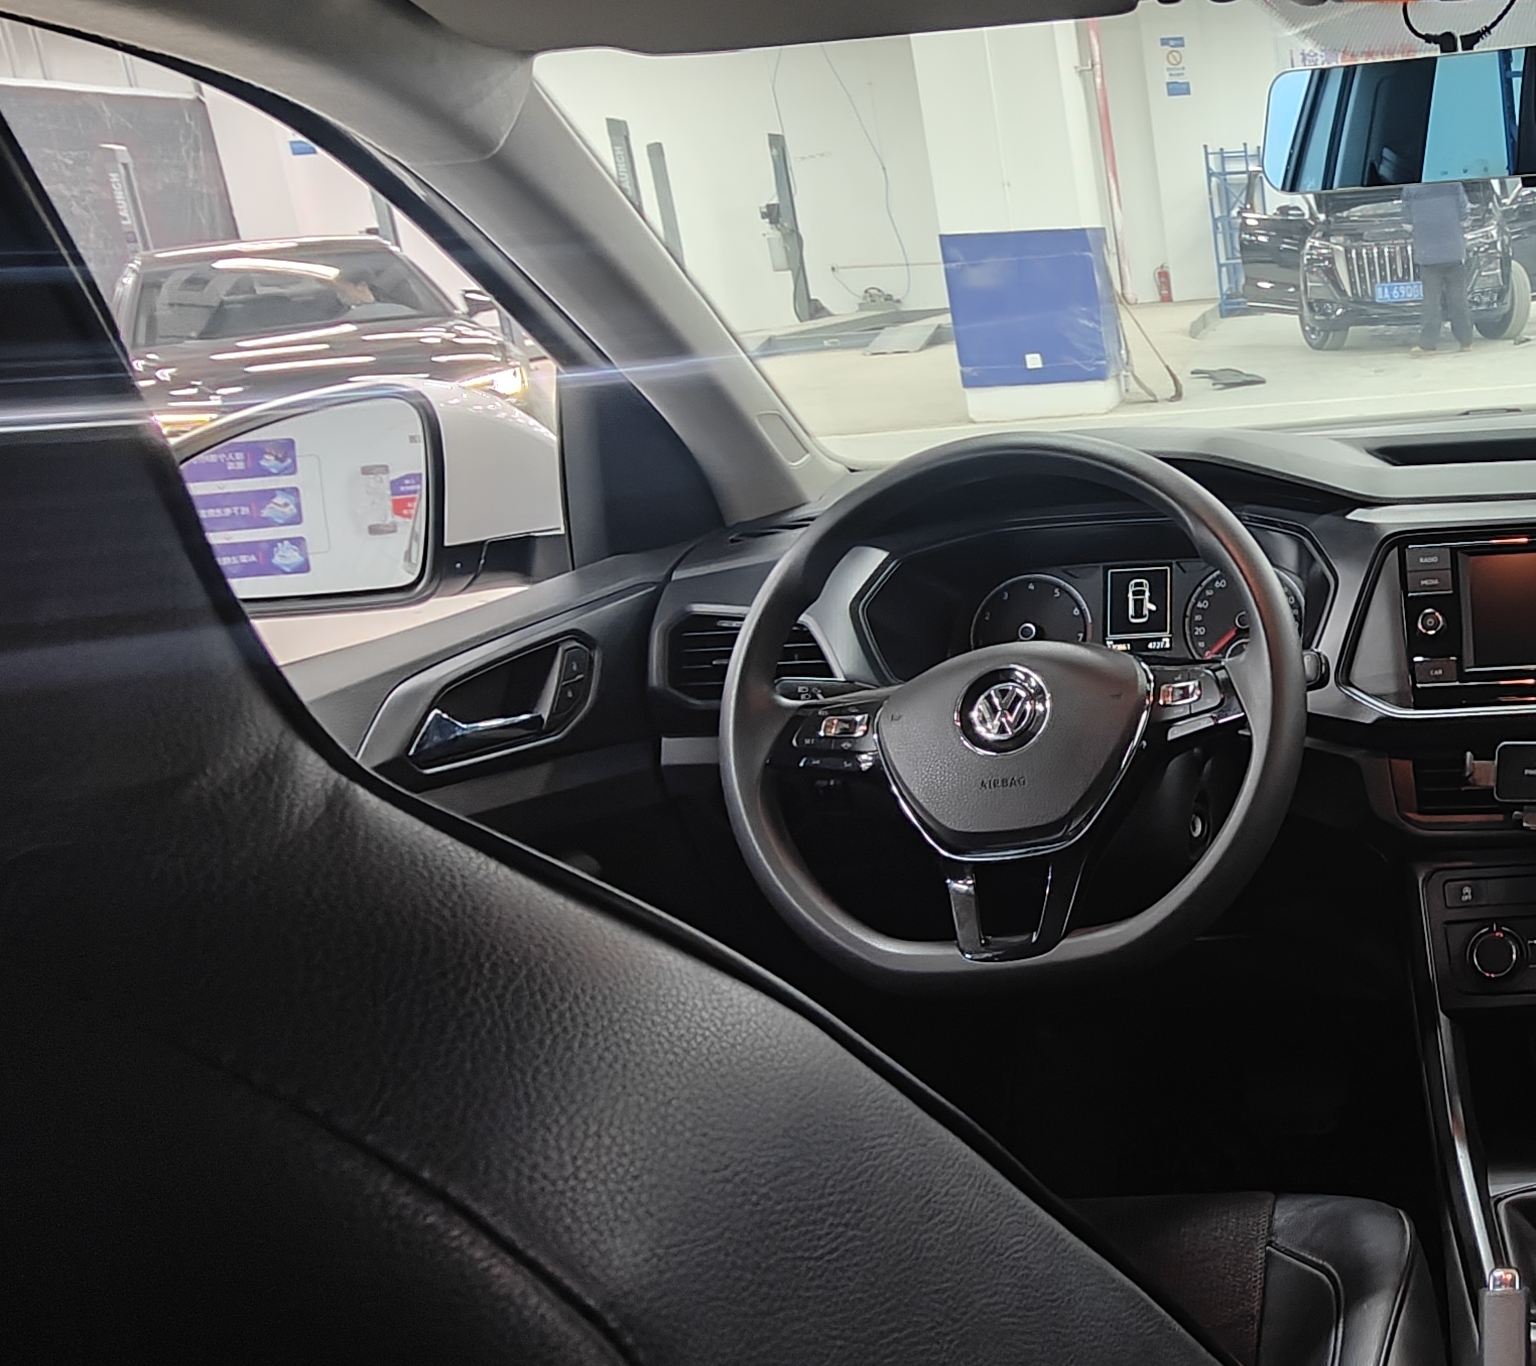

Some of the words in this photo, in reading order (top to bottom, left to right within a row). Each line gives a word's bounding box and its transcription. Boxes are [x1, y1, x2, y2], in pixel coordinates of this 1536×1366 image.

[109, 172, 132, 225] LAUNCH
[1214, 579, 1227, 588] 60
[1197, 600, 1209, 609] 40
[1194, 627, 1206, 635] 20
[980, 777, 1026, 790] AIRBAG
